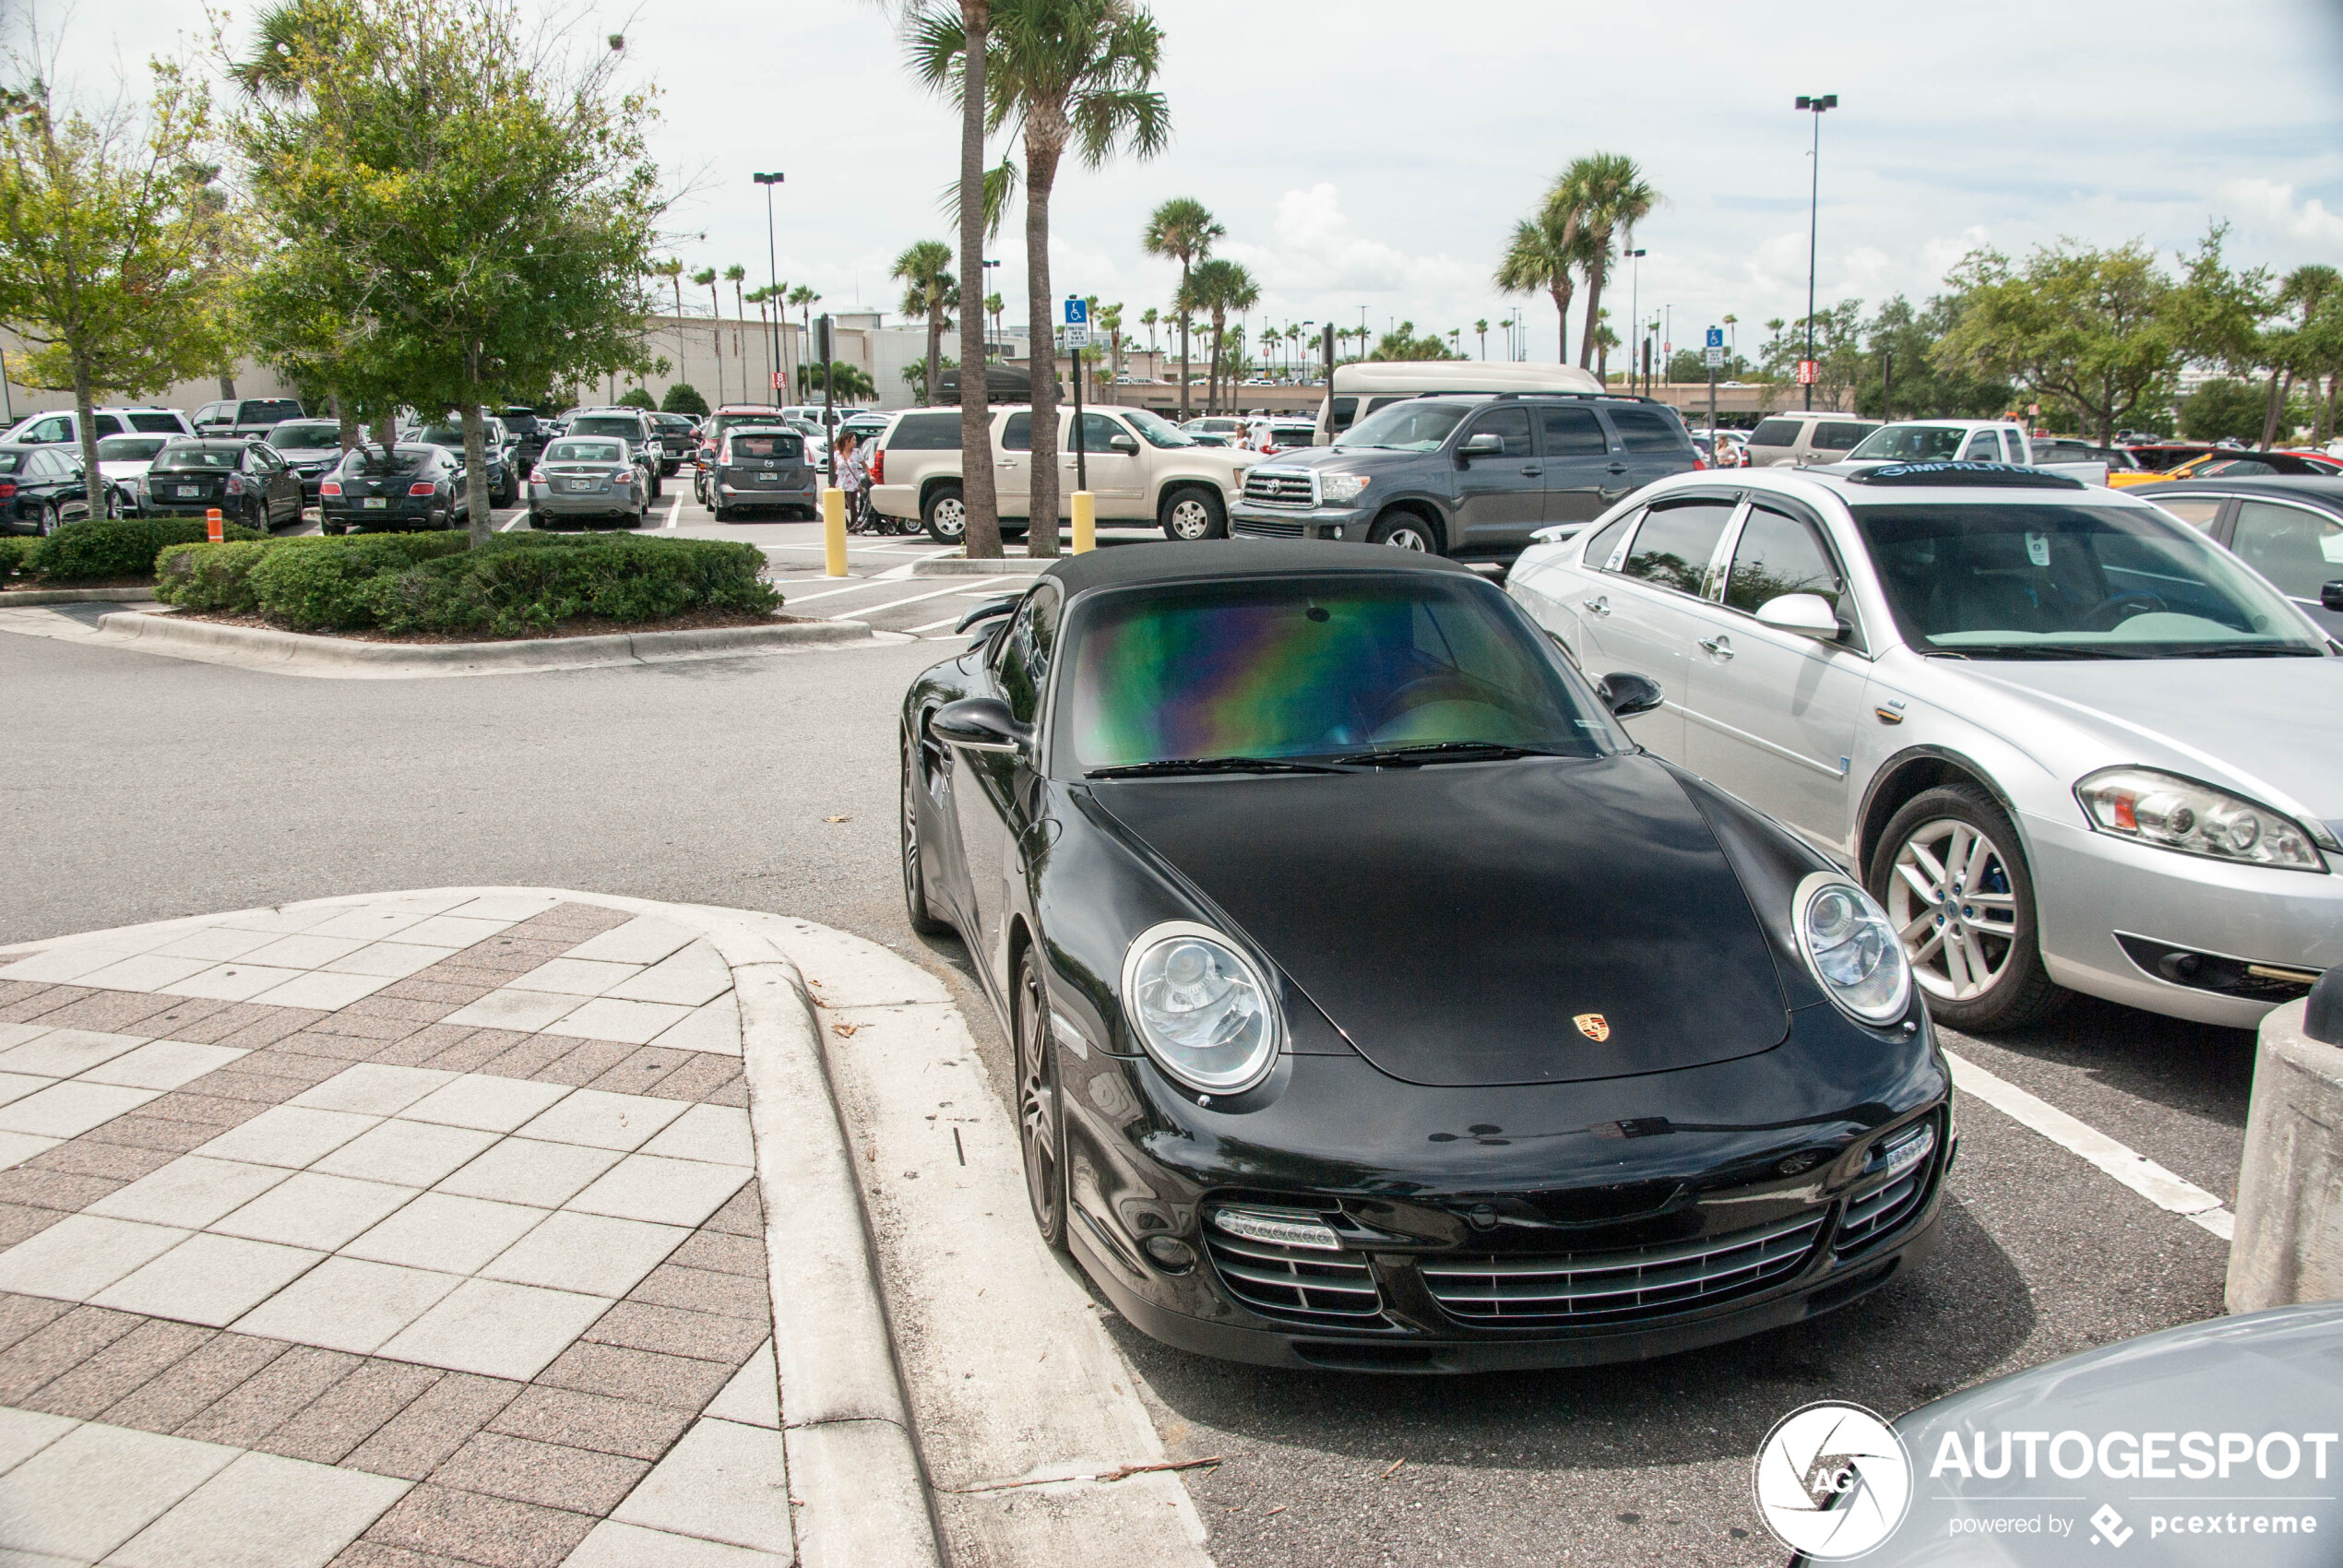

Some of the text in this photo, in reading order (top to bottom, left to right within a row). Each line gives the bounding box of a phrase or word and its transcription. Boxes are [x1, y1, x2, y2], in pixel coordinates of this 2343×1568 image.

[1801, 362, 1809, 374] B
[777, 373, 784, 381] B
[1800, 374, 1811, 384] 13
[1905, 462, 2005, 473] IMPALA
